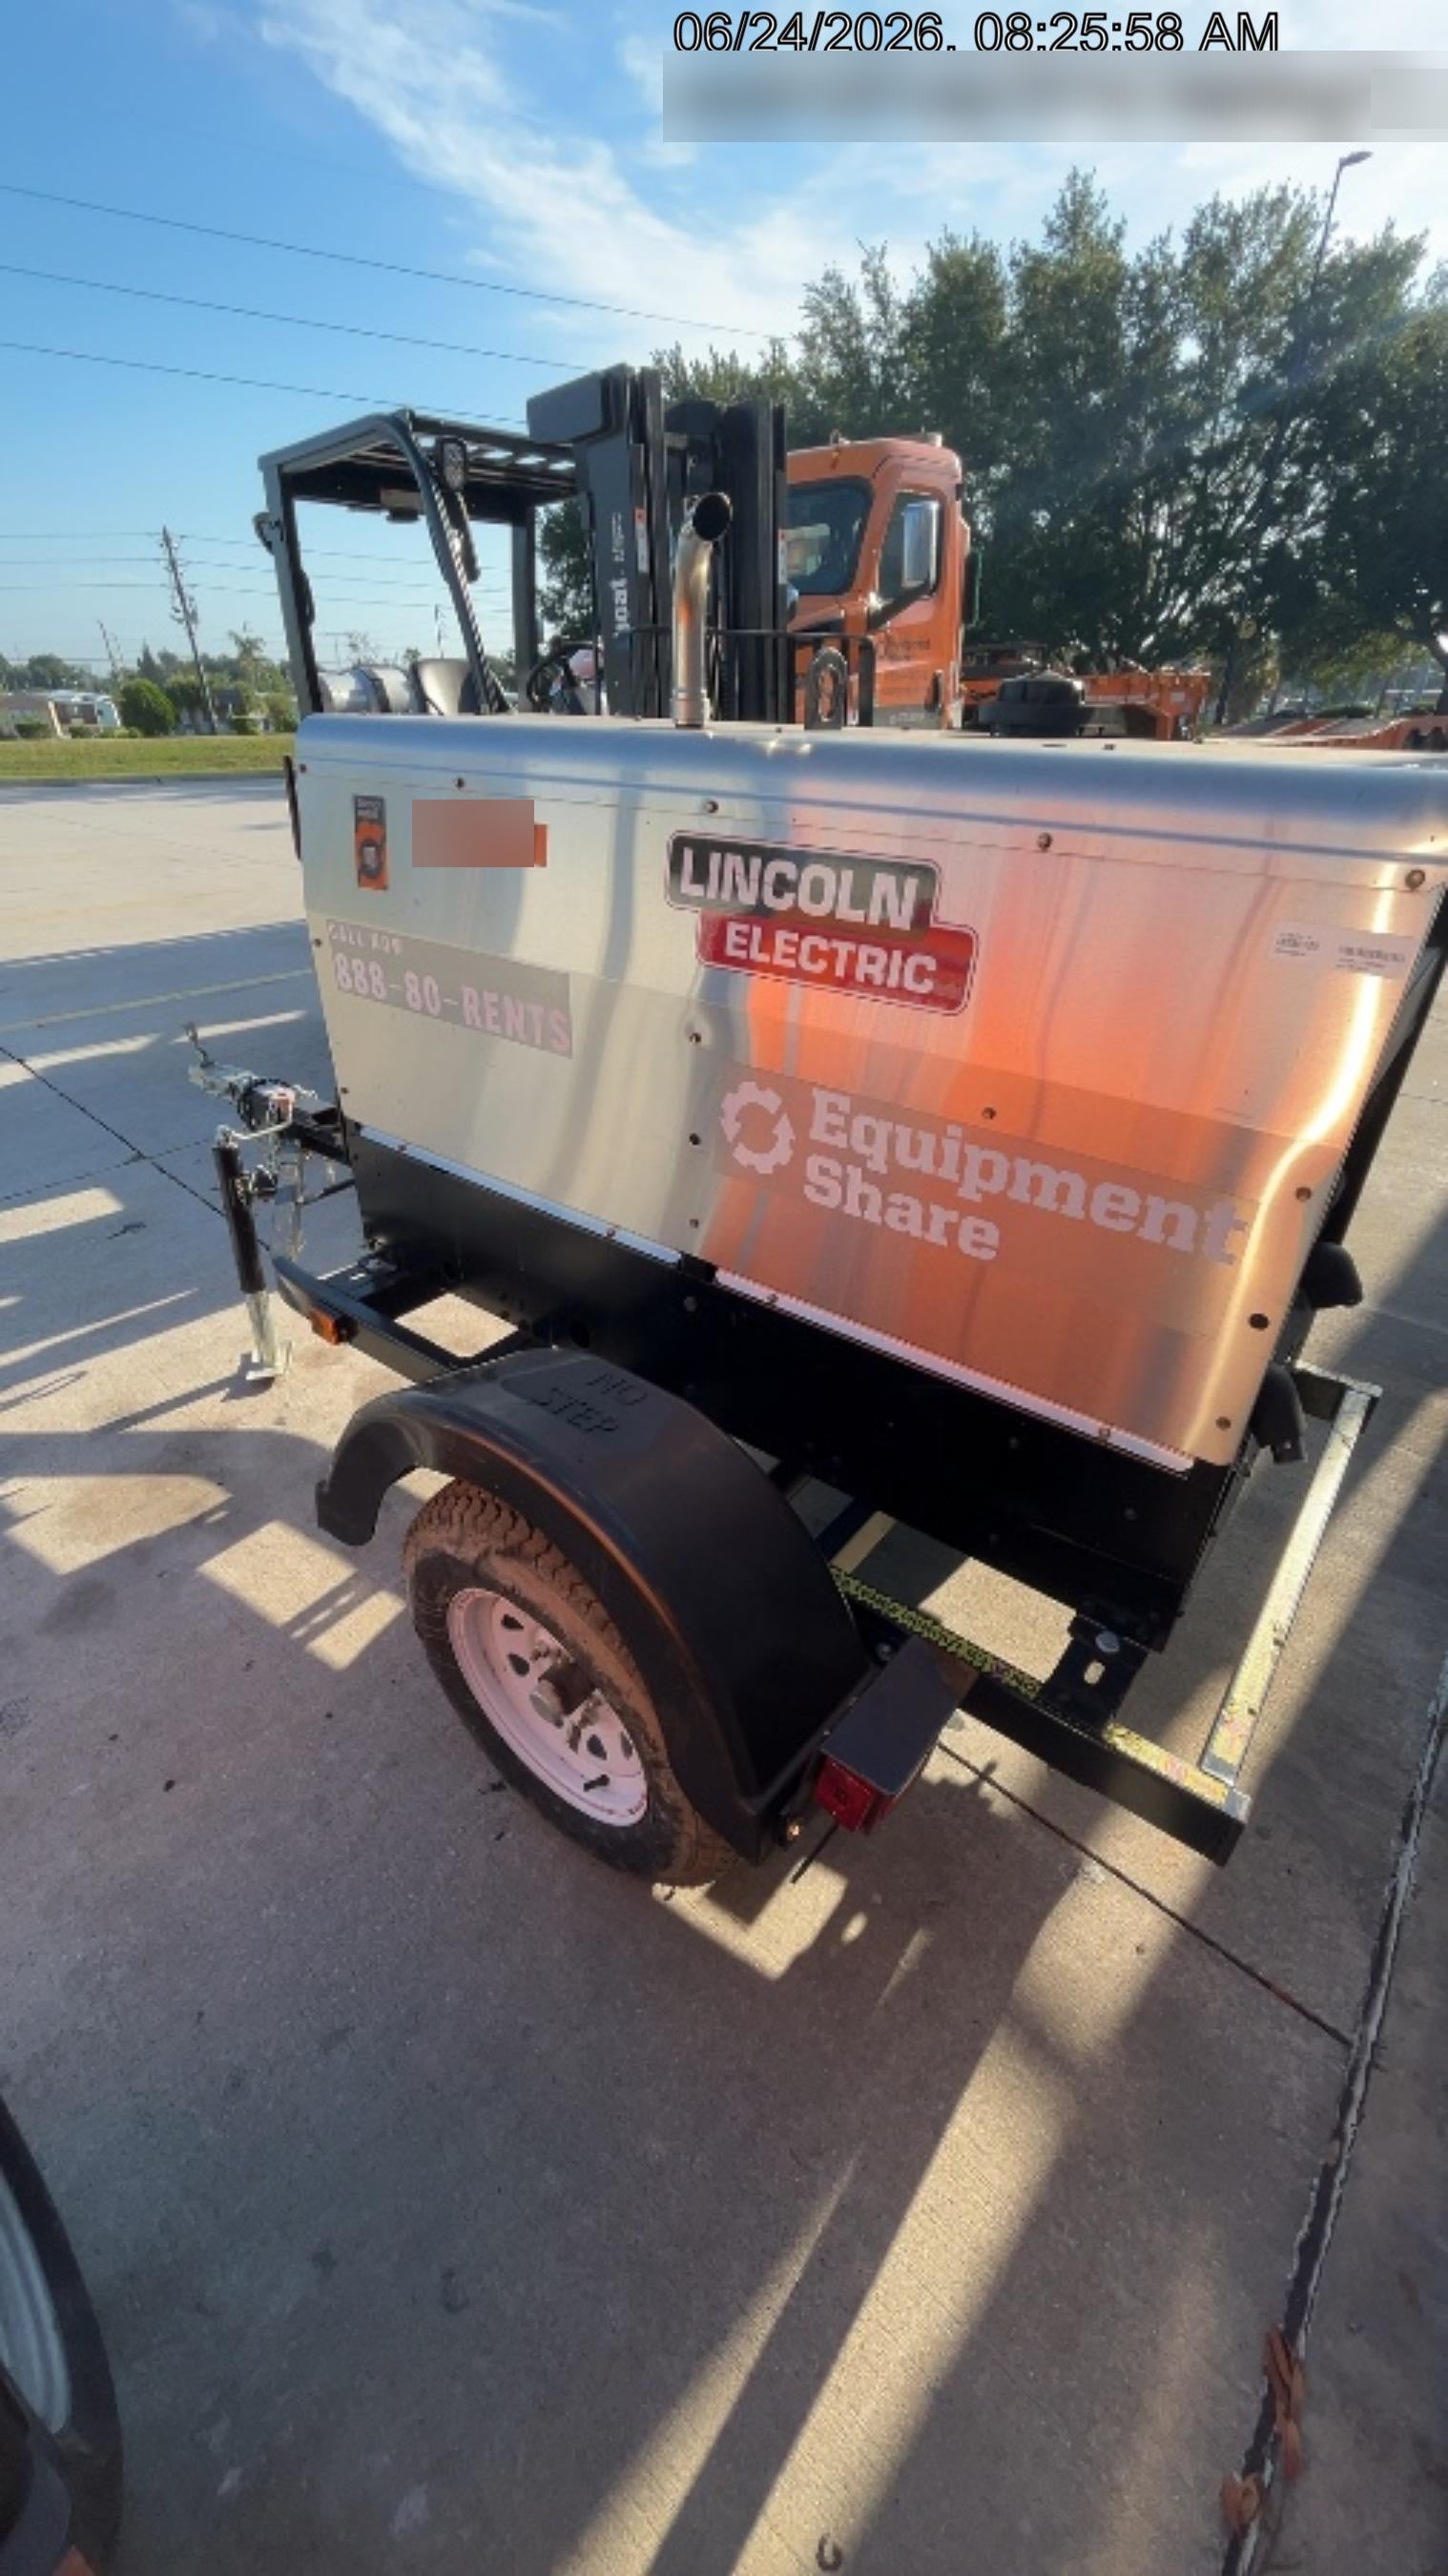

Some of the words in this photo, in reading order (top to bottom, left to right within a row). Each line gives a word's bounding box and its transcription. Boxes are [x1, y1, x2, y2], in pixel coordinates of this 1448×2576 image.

[679, 846, 919, 931] LINCOLN
[333, 952, 570, 1055] 888-80-RENTS
[724, 921, 938, 994] ELECTRIC
[803, 1154, 1001, 1261] Share
[808, 1088, 1250, 1265] Equipment
